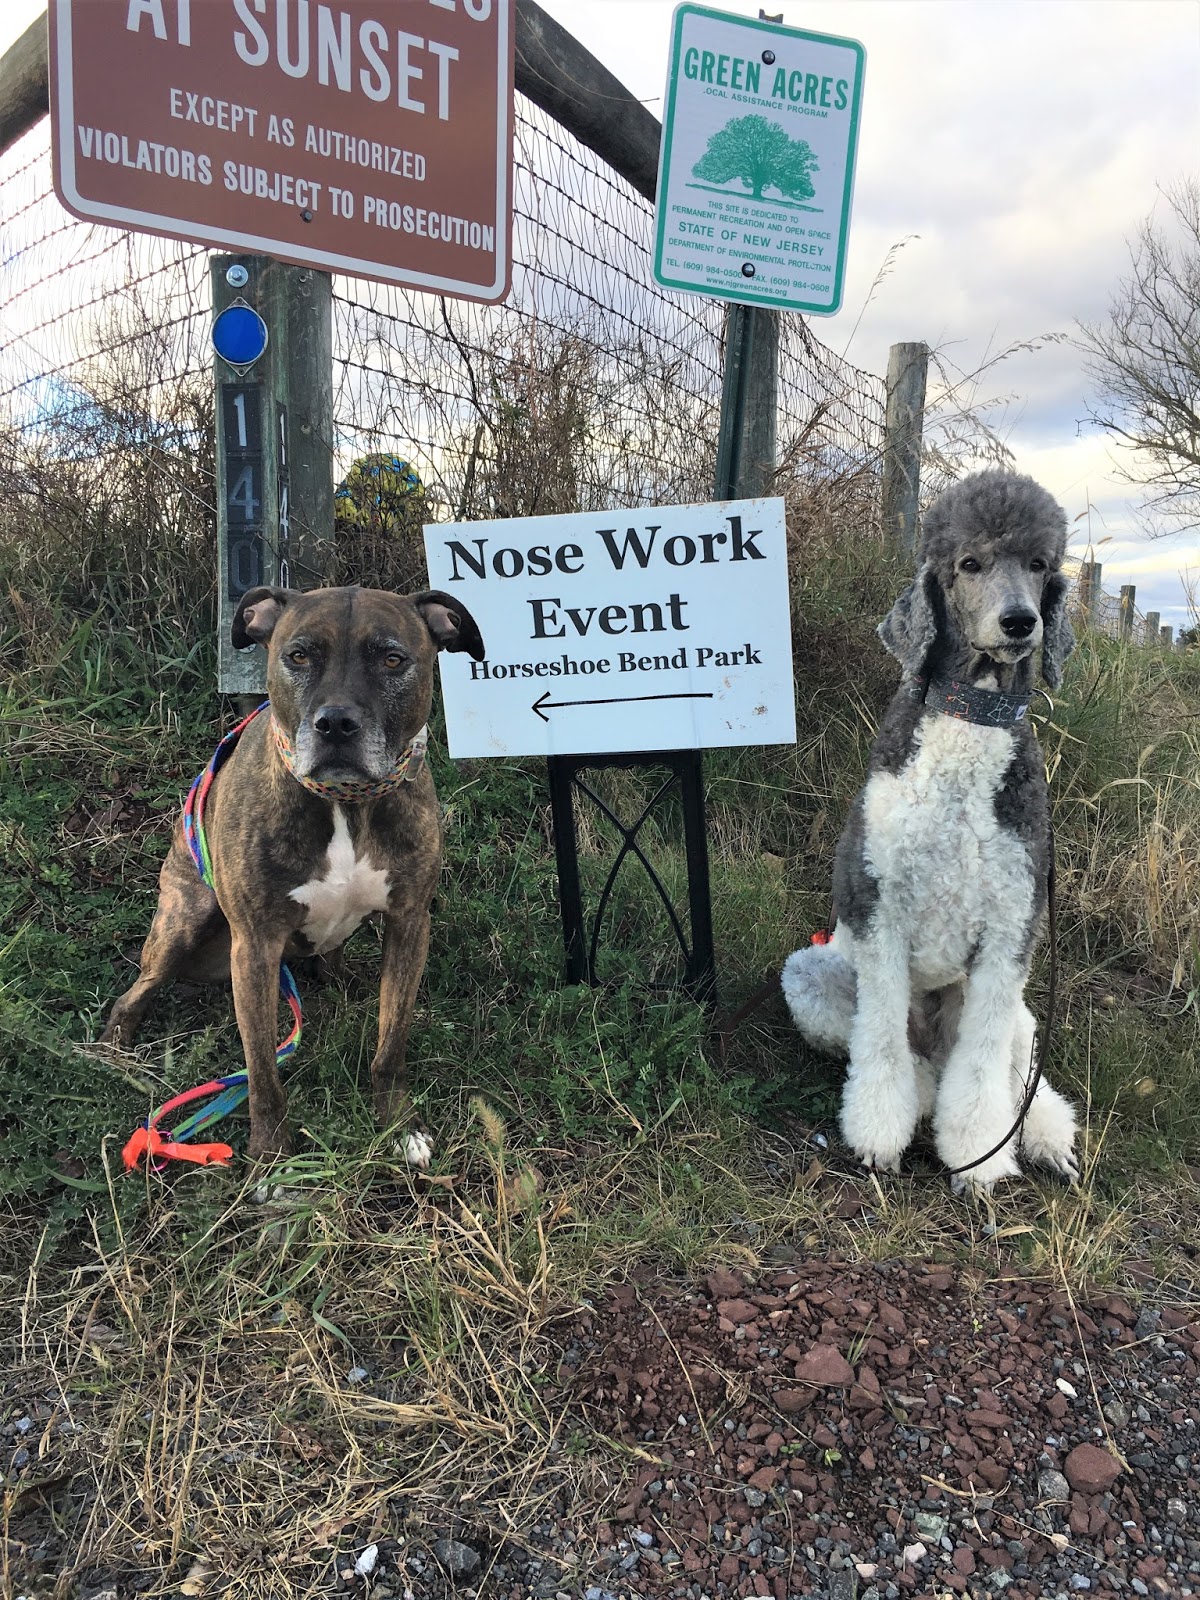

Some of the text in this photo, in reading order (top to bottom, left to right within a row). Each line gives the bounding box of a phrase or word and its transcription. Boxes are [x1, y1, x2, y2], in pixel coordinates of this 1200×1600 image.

[233, 0, 459, 121] SUNSET
[684, 47, 849, 110] GREEN ACRES
[703, 87, 828, 118] OCAL ASSISTANCE PROGRAM
[169, 88, 426, 182] EXCEPT AS AUTHORIZED
[78, 125, 494, 252] VIOLATORS SUBJECT TO PROSECUTION
[672, 204, 831, 240] PERMANENT RECREATION AND OPEN SPACE
[708, 201, 799, 224] THIS SITE IS DEDICATED TO
[668, 237, 831, 272] DEPARTMENT OF ENVIRONMENTAL PROTECTION
[678, 221, 824, 257] STATE OF NEW JERSEY
[666, 258, 681, 268] TEL.
[683, 260, 703, 272] (609)
[706, 265, 743, 279] 984-0500
[770, 276, 790, 287] (609)
[706, 276, 787, 297] www.njgreenacres.org
[444, 516, 767, 582] Nose Work
[526, 593, 690, 639] Event
[469, 643, 763, 680] Horseshoe Bend Park
